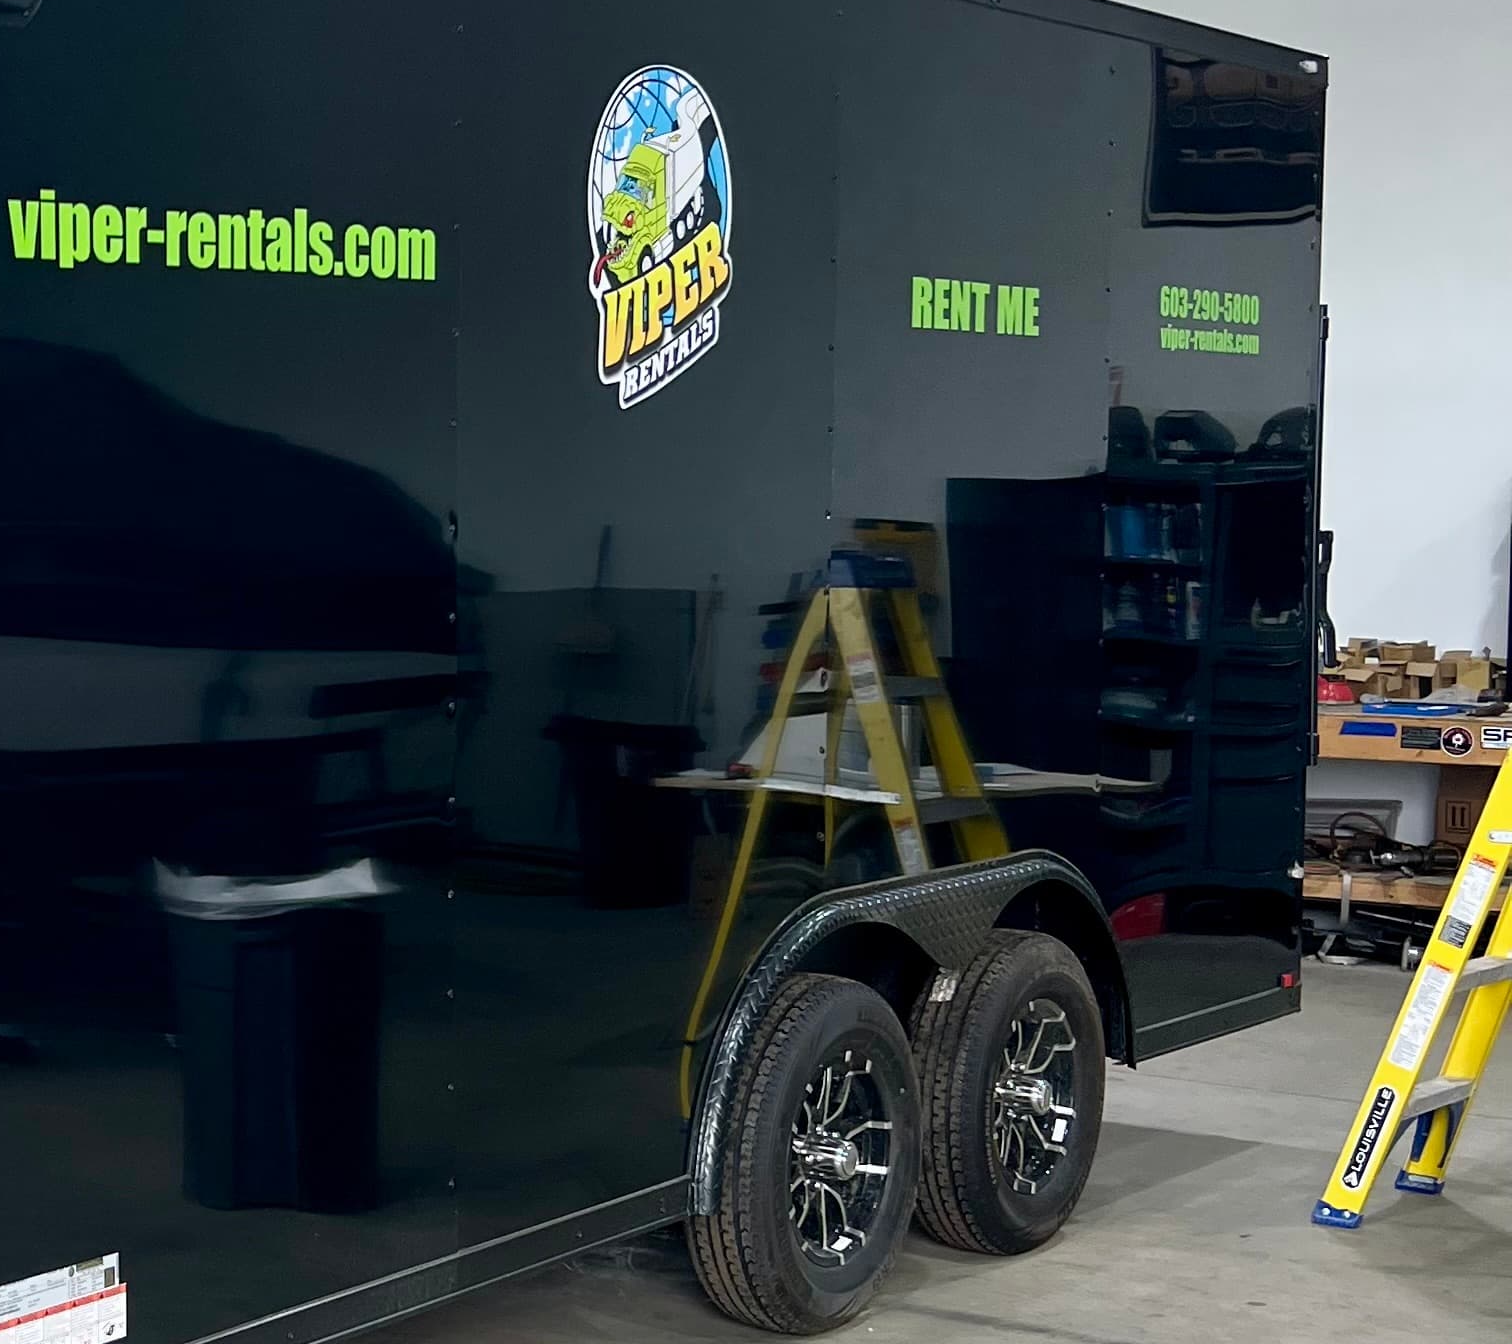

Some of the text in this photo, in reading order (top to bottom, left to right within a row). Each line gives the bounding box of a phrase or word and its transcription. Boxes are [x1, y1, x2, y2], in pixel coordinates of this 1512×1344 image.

[7, 188, 437, 282] viper-rentals.com
[603, 220, 729, 369] VIPER
[911, 275, 1041, 338] RENT ME
[1159, 284, 1261, 326] 603-290-5800
[623, 308, 715, 401] RENTALS
[1160, 323, 1261, 356] viper-rentals.com
[1350, 1088, 1393, 1173] LOUISVILLE
